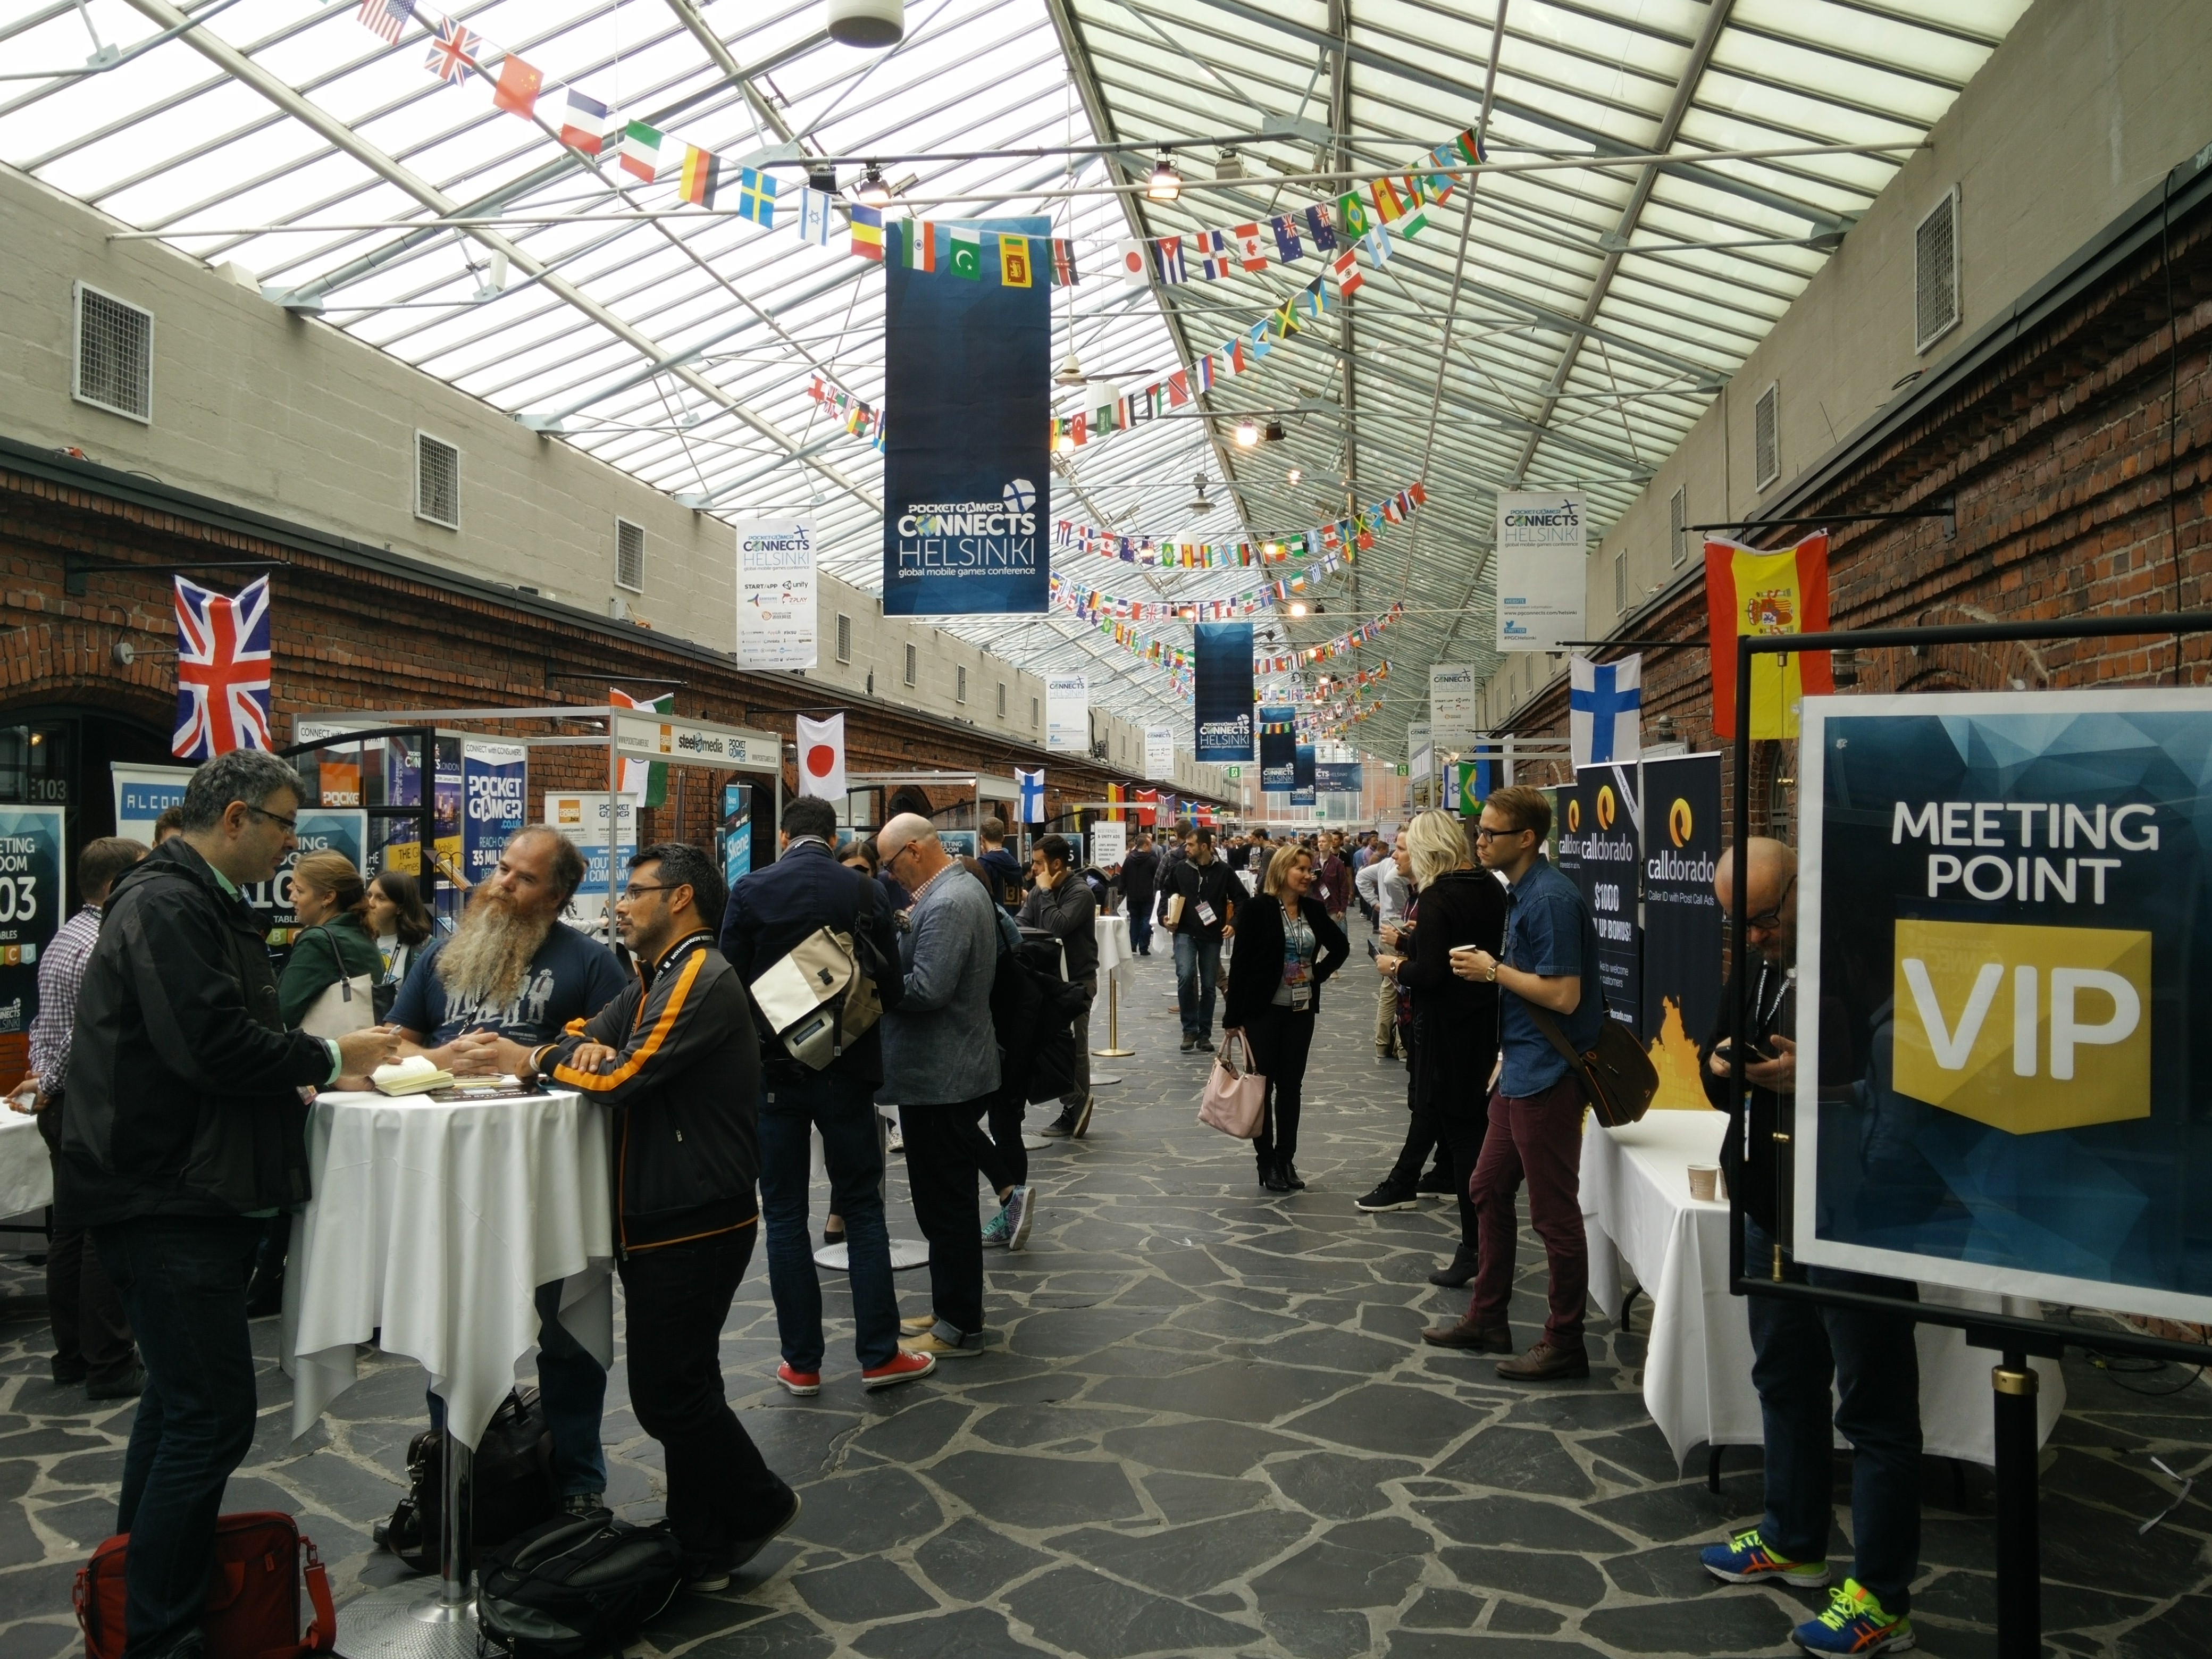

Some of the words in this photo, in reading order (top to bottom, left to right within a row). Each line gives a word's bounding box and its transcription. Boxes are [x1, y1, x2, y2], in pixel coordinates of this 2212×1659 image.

[908, 504, 956, 513] POCKET
[956, 502, 1003, 514] GAMER
[898, 513, 1036, 537] CONNECTS
[1505, 515, 1579, 526] CONNECTS
[1505, 527, 1578, 542] HELSINKI
[743, 540, 809, 551] CONNECTS
[900, 538, 1034, 566] HELSINKI
[744, 552, 809, 566] HELSINKI
[899, 568, 925, 578] global
[927, 567, 956, 576] mobile
[958, 568, 986, 577] games
[300, 727, 331, 738] CONNECT
[1200, 726, 1250, 735] CONNECTS
[678, 734, 695, 750] steel
[702, 738, 723, 753] media
[728, 739, 746, 749] POCKET
[1200, 735, 1249, 745] HELSINKI
[466, 744, 488, 753] CONNECT
[498, 747, 522, 756] CONSUMERS
[441, 763, 460, 771] LONDON
[38, 780, 66, 800] 103
[469, 776, 522, 798] POCKET
[323, 791, 360, 805] POCKE
[469, 794, 523, 822] GAMER
[1892, 801, 2159, 851] MEETING
[435, 842, 453, 852] Mobile
[480, 837, 496, 848] REACH
[728, 833, 749, 862] Skene
[1581, 833, 1632, 862] calldorado
[399, 849, 411, 859] THE
[473, 850, 484, 866] 35
[485, 850, 501, 866] MILL
[398, 863, 419, 873] Games
[1648, 850, 1715, 883] calldorado
[590, 869, 630, 882] COMANY
[1928, 854, 2122, 904] POINT
[1595, 882, 1619, 911] $1000
[1648, 890, 1662, 901] Caller
[1662, 891, 1668, 901] ID
[1669, 892, 1679, 902] with
[1680, 893, 1692, 903] Post
[1693, 894, 1703, 904] Call
[1704, 895, 1714, 906] Ads
[273, 932, 281, 941] B
[1599, 919, 1607, 938] UP
[1607, 919, 1631, 942] BONUS!
[9, 948, 17, 961] C
[24, 946, 32, 959] D
[671, 936, 701, 960] ACQUISITION
[1610, 964, 1629, 976] welcome
[649, 969, 664, 992] ROADHO
[1602, 976, 1623, 988] customers
[1610, 1008, 1632, 1023] dorado.com
[1902, 958, 2141, 1081] VIP
